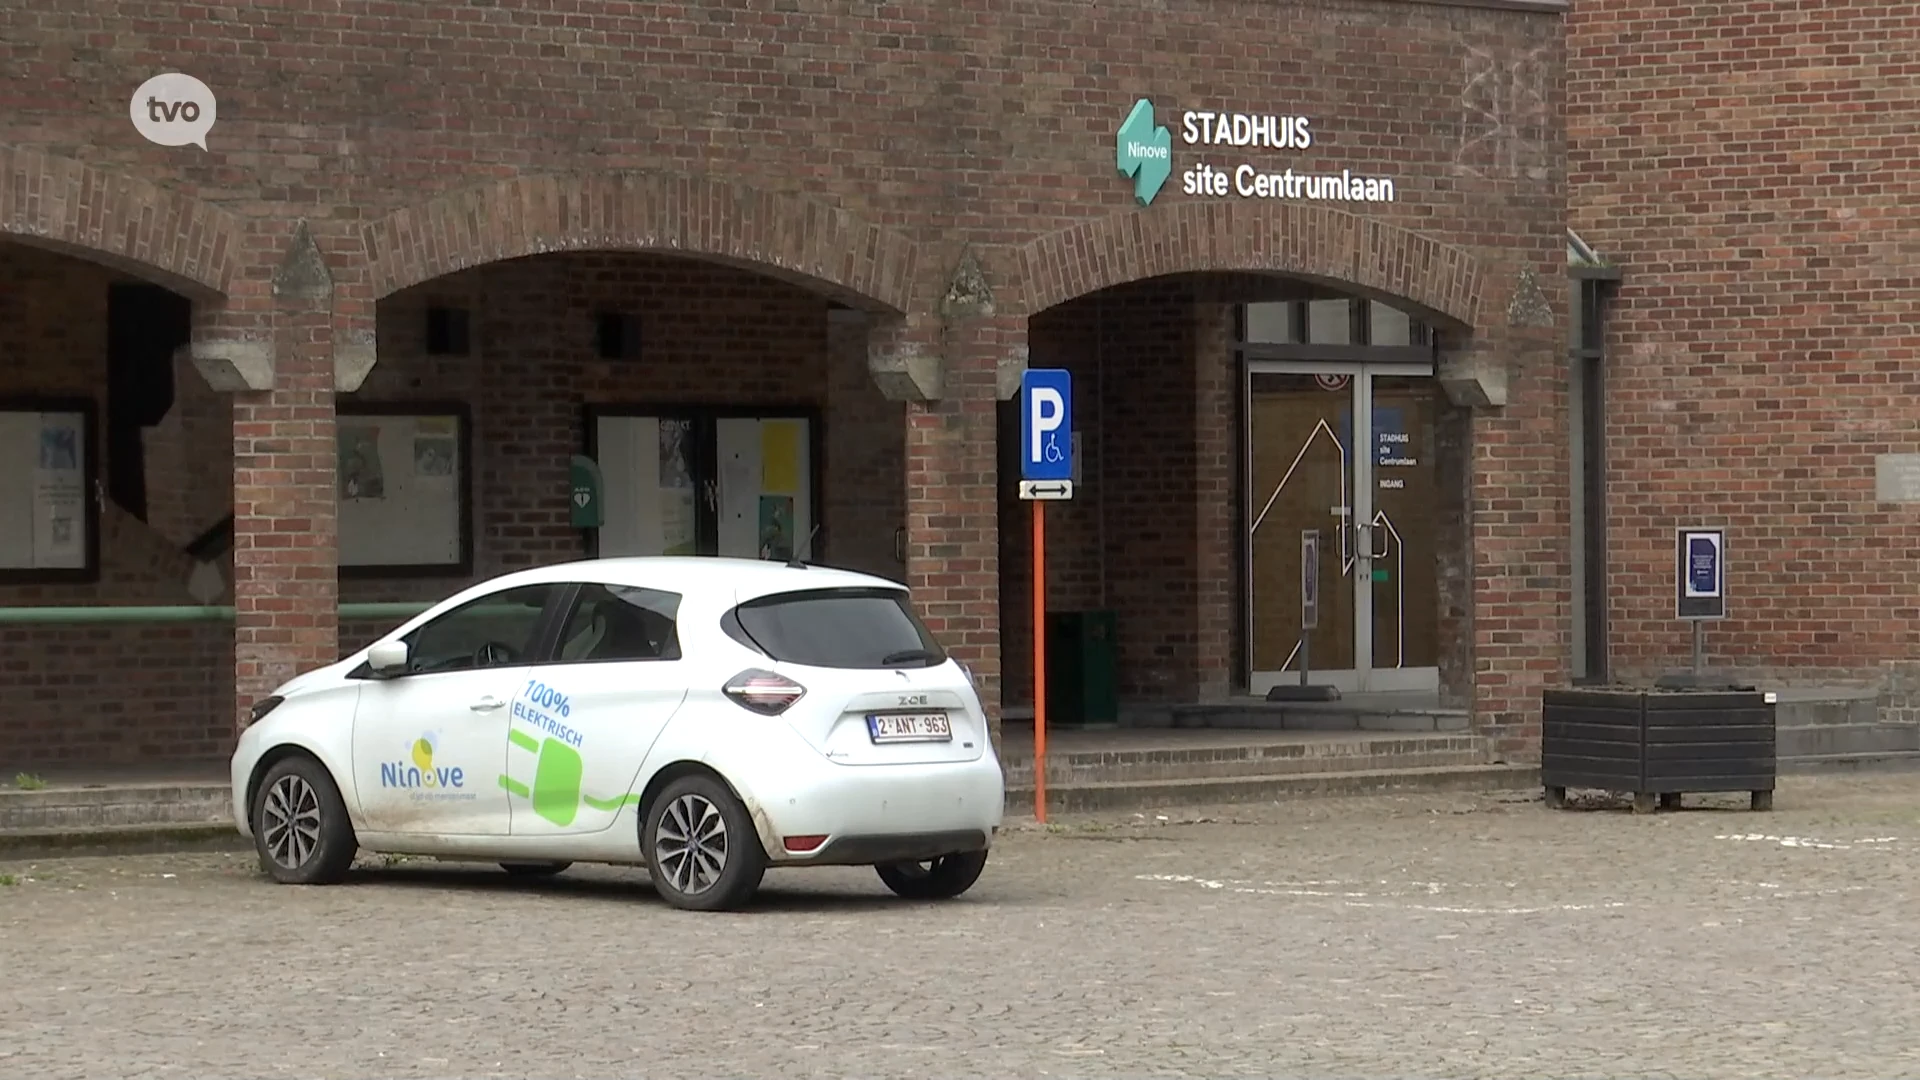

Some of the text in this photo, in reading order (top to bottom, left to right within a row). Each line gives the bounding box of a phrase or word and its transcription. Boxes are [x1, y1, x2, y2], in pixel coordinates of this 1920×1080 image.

[1182, 111, 1311, 149] STADHUIS
[1127, 141, 1168, 159] Ninove
[1182, 163, 1394, 202] site Centrumlaan
[1031, 387, 1065, 463] P
[1379, 433, 1409, 443] STADHUIS
[1379, 479, 1404, 488] INGANG
[523, 679, 570, 718] 100%
[513, 701, 583, 748] ELEKTRISCH
[381, 761, 464, 789] Ninove
